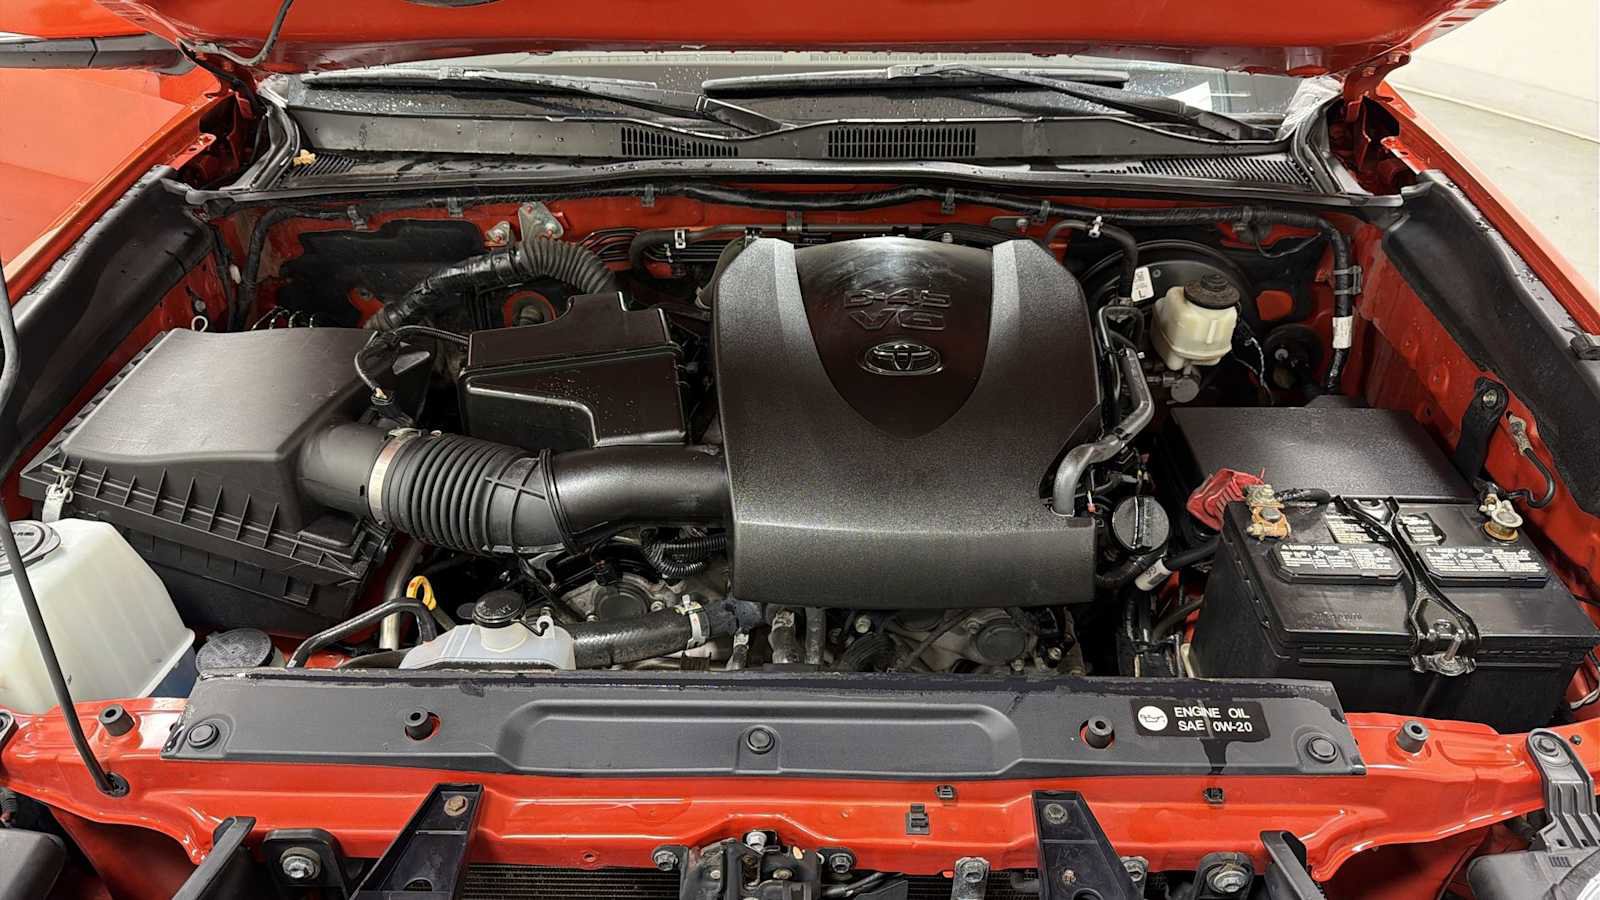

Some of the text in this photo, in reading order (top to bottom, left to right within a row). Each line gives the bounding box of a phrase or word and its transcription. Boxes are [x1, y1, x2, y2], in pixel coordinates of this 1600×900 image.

[848, 308, 946, 331] V6
[1173, 706, 1250, 719] ENGINE OIL
[1177, 719, 1253, 732] SAE 0W-20
